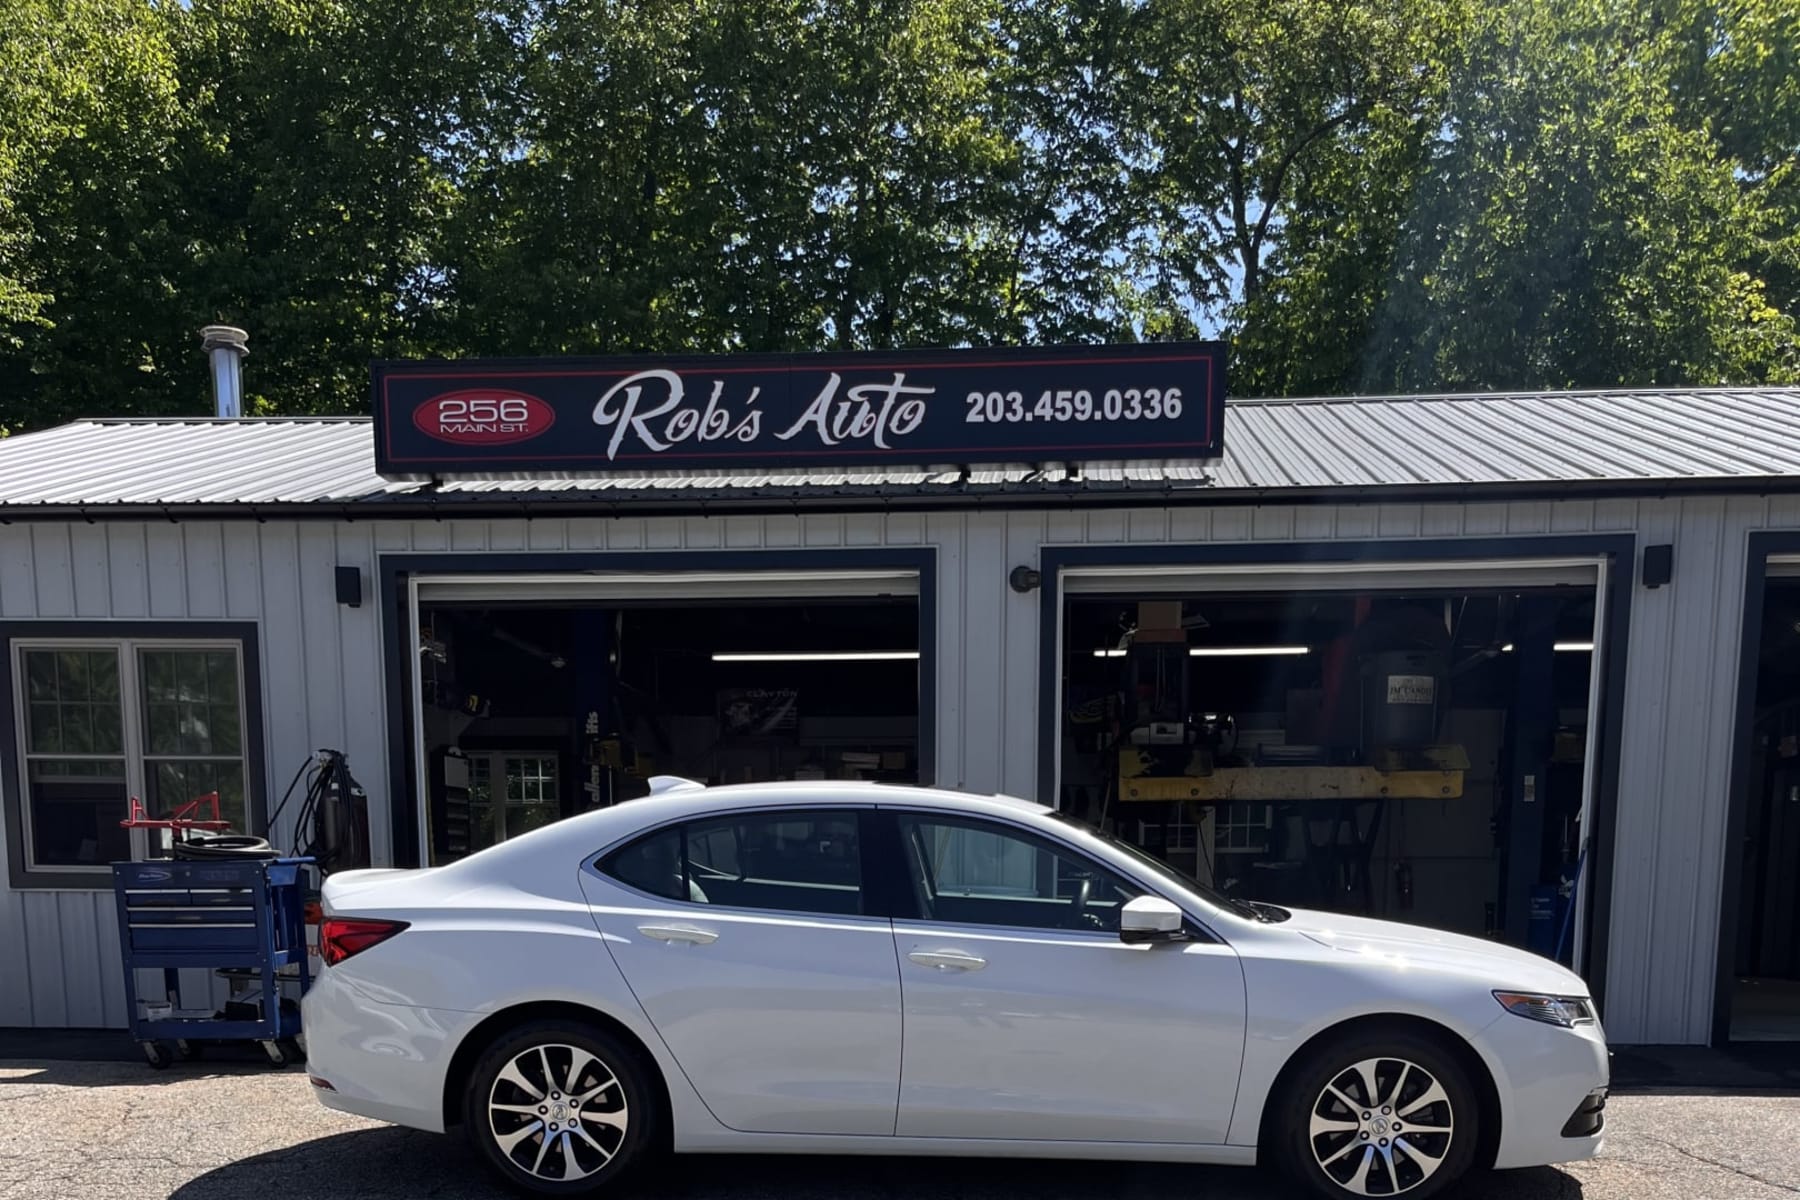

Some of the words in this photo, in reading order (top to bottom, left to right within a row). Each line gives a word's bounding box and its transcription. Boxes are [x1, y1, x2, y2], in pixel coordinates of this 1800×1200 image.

[439, 400, 528, 422] 256
[592, 369, 763, 461] Rob's
[773, 372, 935, 449] Auto
[966, 388, 1183, 423] 203.459.0336
[440, 424, 497, 433] MAIN
[500, 423, 528, 433] ST.
